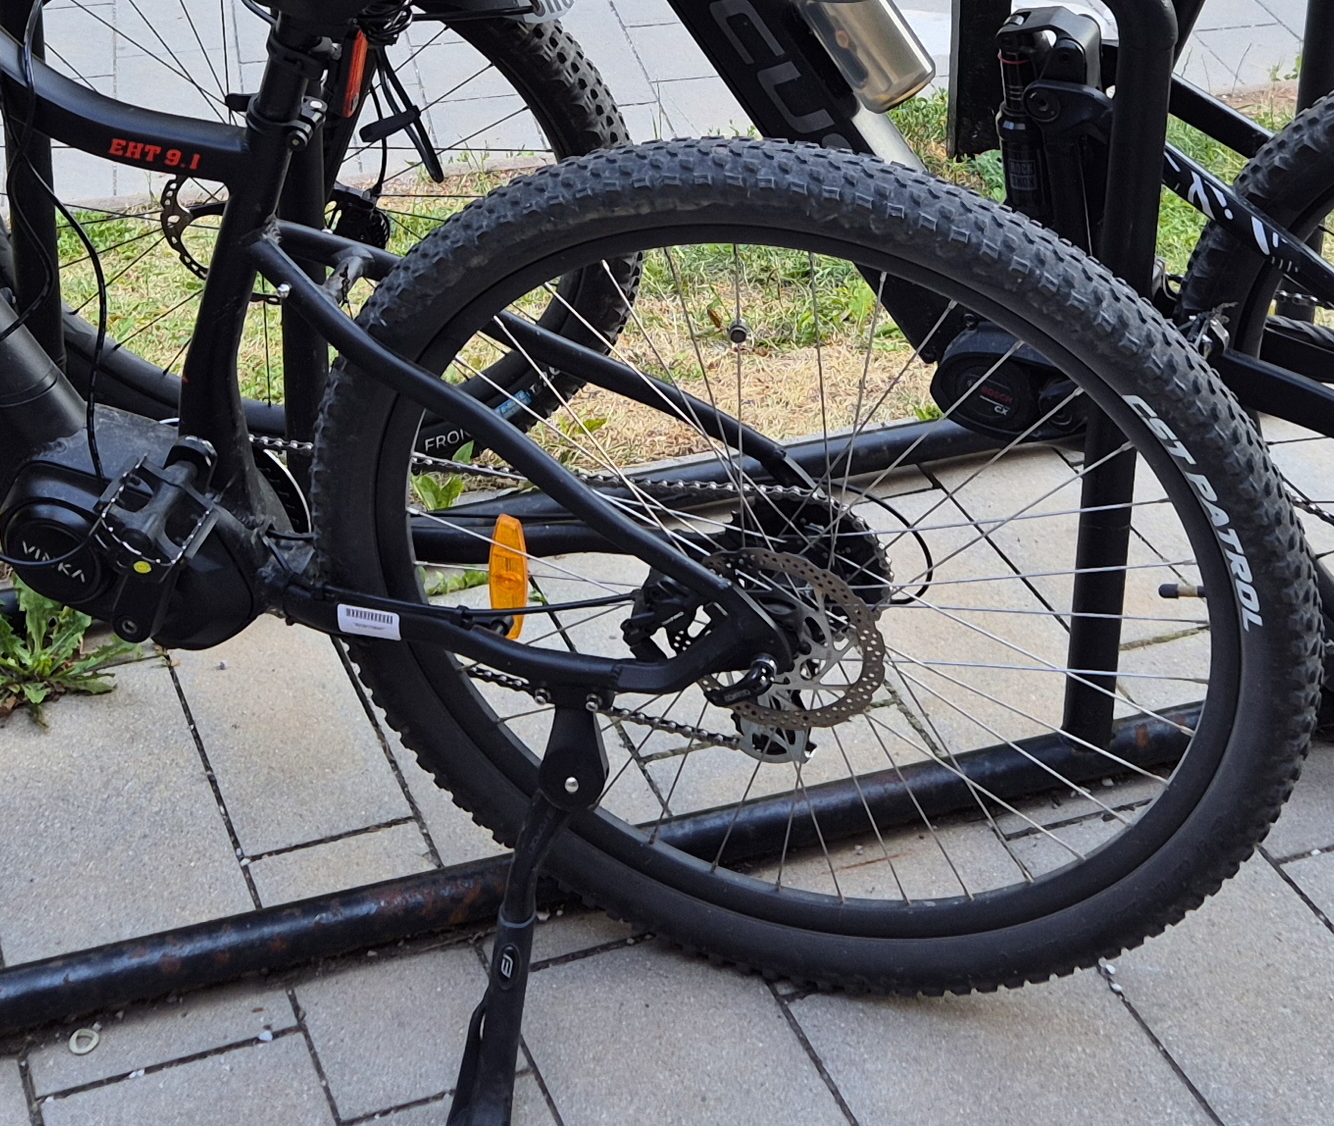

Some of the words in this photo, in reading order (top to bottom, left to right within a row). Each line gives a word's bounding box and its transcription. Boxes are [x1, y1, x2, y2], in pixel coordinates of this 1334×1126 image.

[109, 138, 162, 162] EHT
[164, 149, 201, 170] 9.1
[1122, 395, 1197, 465] CST
[1186, 472, 1263, 633] PATROL
